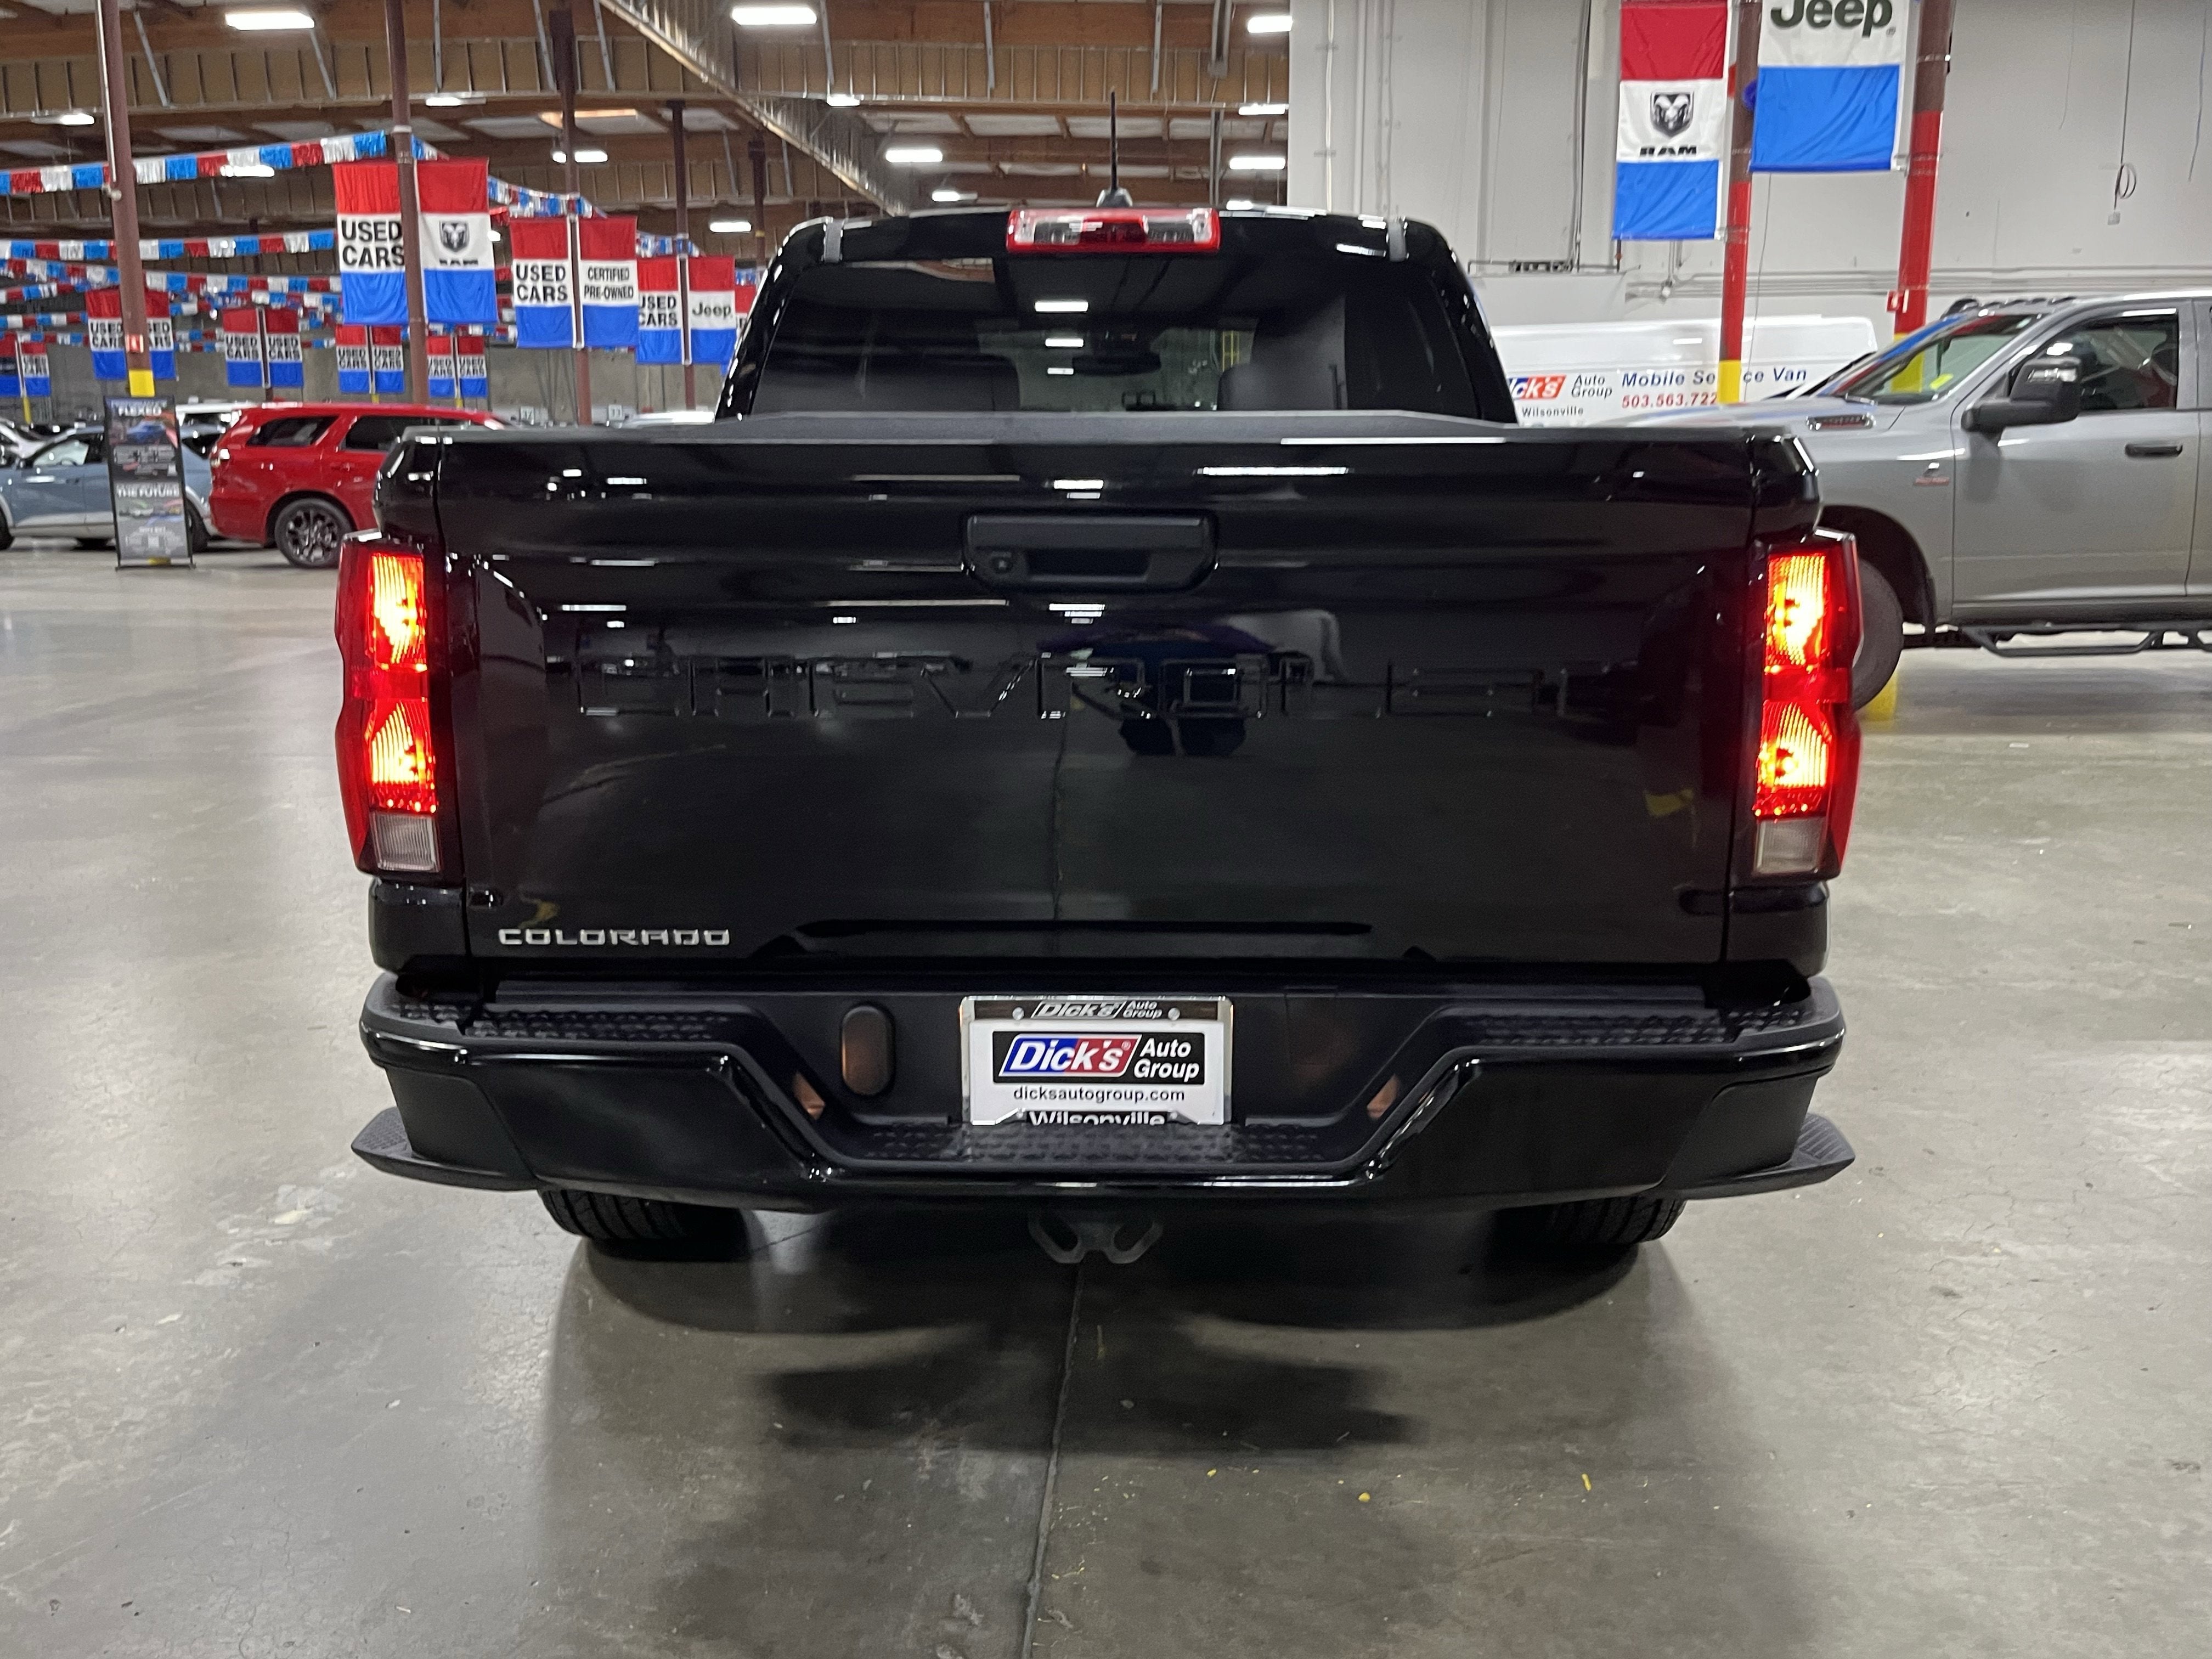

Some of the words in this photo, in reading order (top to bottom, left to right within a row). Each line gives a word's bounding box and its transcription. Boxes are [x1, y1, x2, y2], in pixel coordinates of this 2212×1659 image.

[1771, 0, 1892, 38] Jeep
[341, 219, 402, 242] USED
[342, 245, 404, 268] CARS
[516, 264, 566, 281] USED
[588, 267, 630, 281] CERTIFIED
[517, 284, 567, 302] CARS
[584, 285, 634, 300] PRE-OWNED
[692, 302, 731, 319] Jeep
[147, 321, 170, 333] SED
[1574, 374, 1605, 386] Auto
[1621, 371, 1685, 388] Mobile
[1693, 370, 1764, 385] Sece
[1773, 367, 1807, 382] Van
[1571, 386, 1612, 399] Group
[1522, 405, 1584, 417] Wilsonville
[499, 928, 730, 945] COLORADO
[1039, 1003, 1115, 1017] Dick's
[1123, 1008, 1163, 1019] Group
[1126, 1000, 1158, 1010] Auto
[1009, 1039, 1122, 1071] Dick's
[1139, 1038, 1191, 1058] Auto
[1133, 1058, 1200, 1082] Group
[1014, 1087, 1185, 1104] dicksautogroup.com
